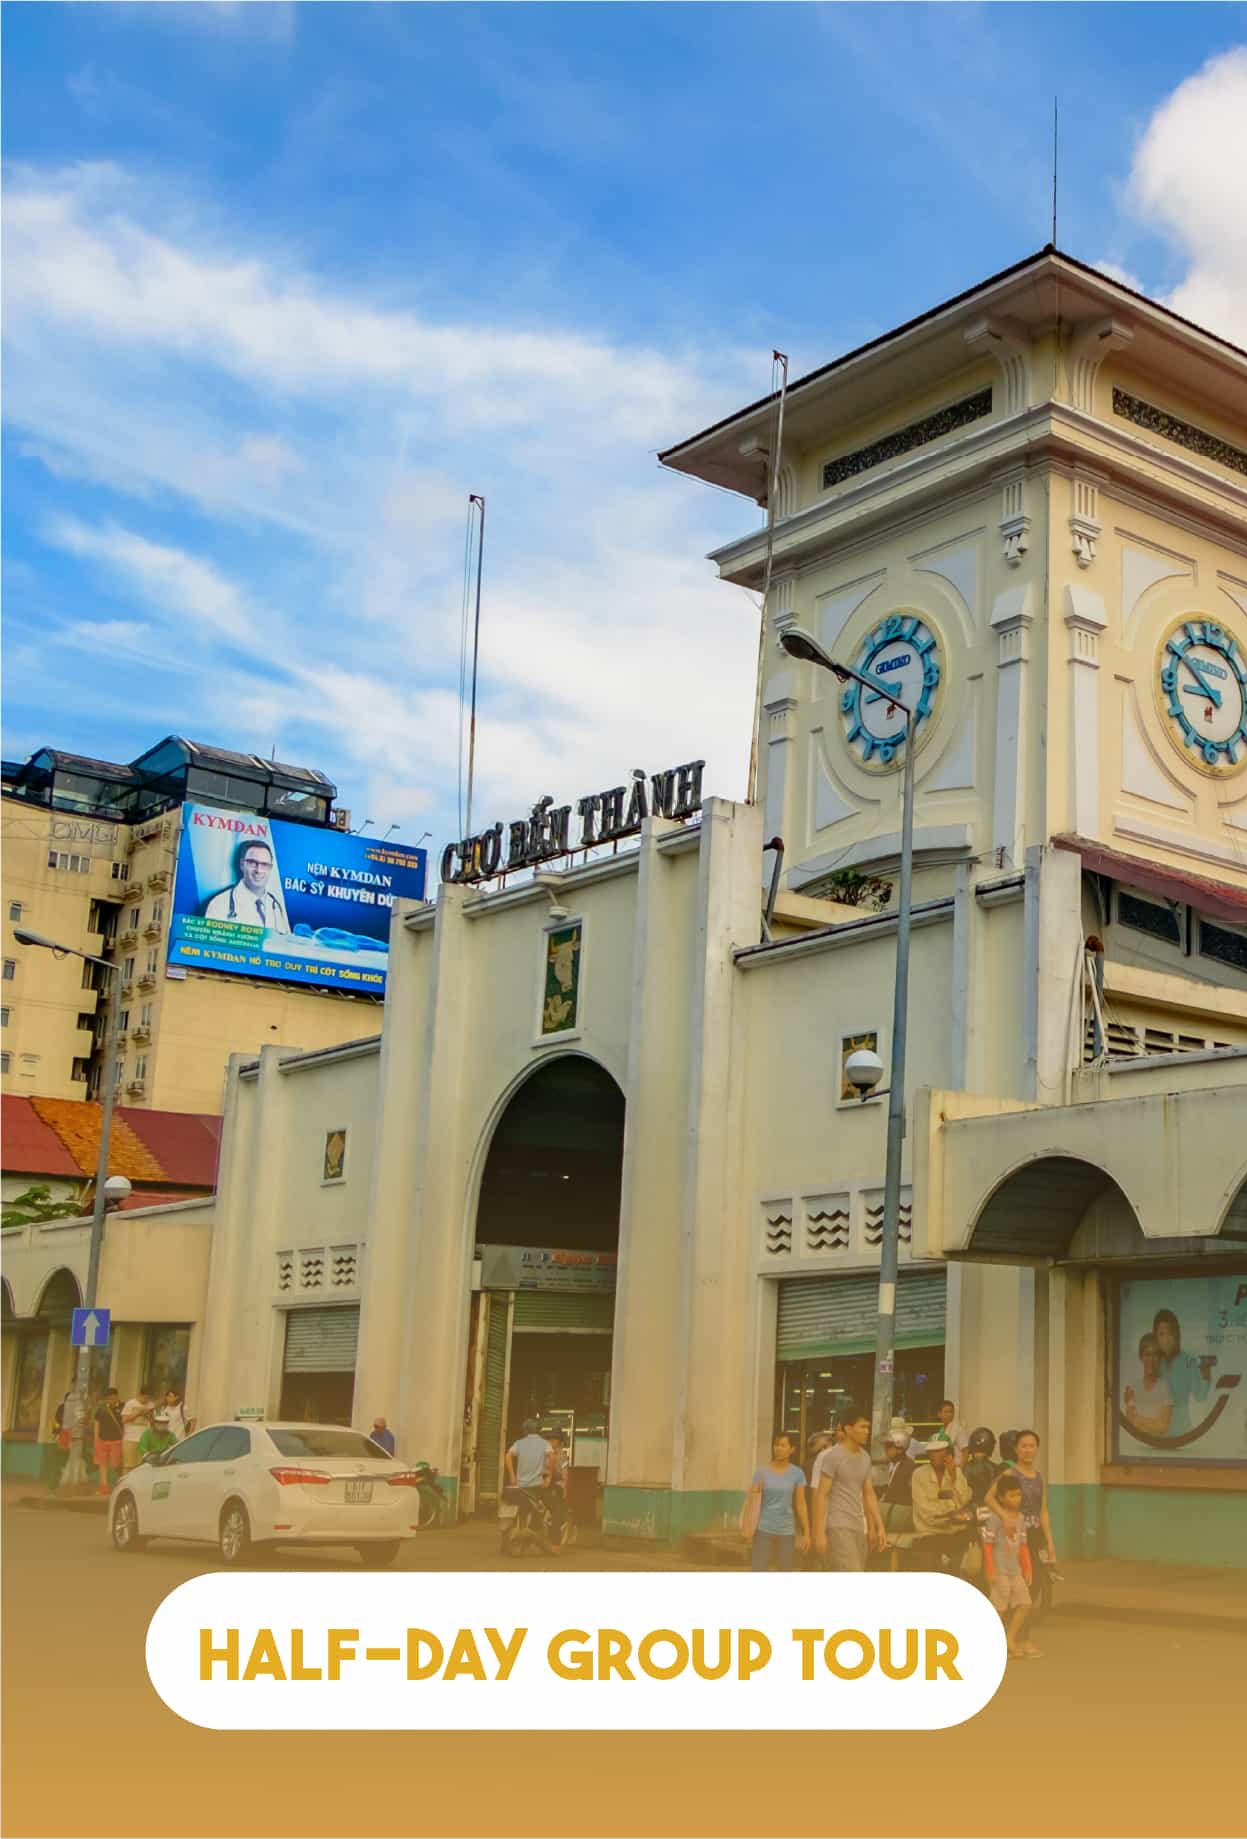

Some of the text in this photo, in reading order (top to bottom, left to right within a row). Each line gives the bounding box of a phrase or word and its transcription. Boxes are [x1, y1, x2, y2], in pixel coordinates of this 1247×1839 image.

[577, 760, 706, 844] THÀNH
[193, 811, 268, 838] KYMDAN
[330, 866, 392, 887] KYMDAN
